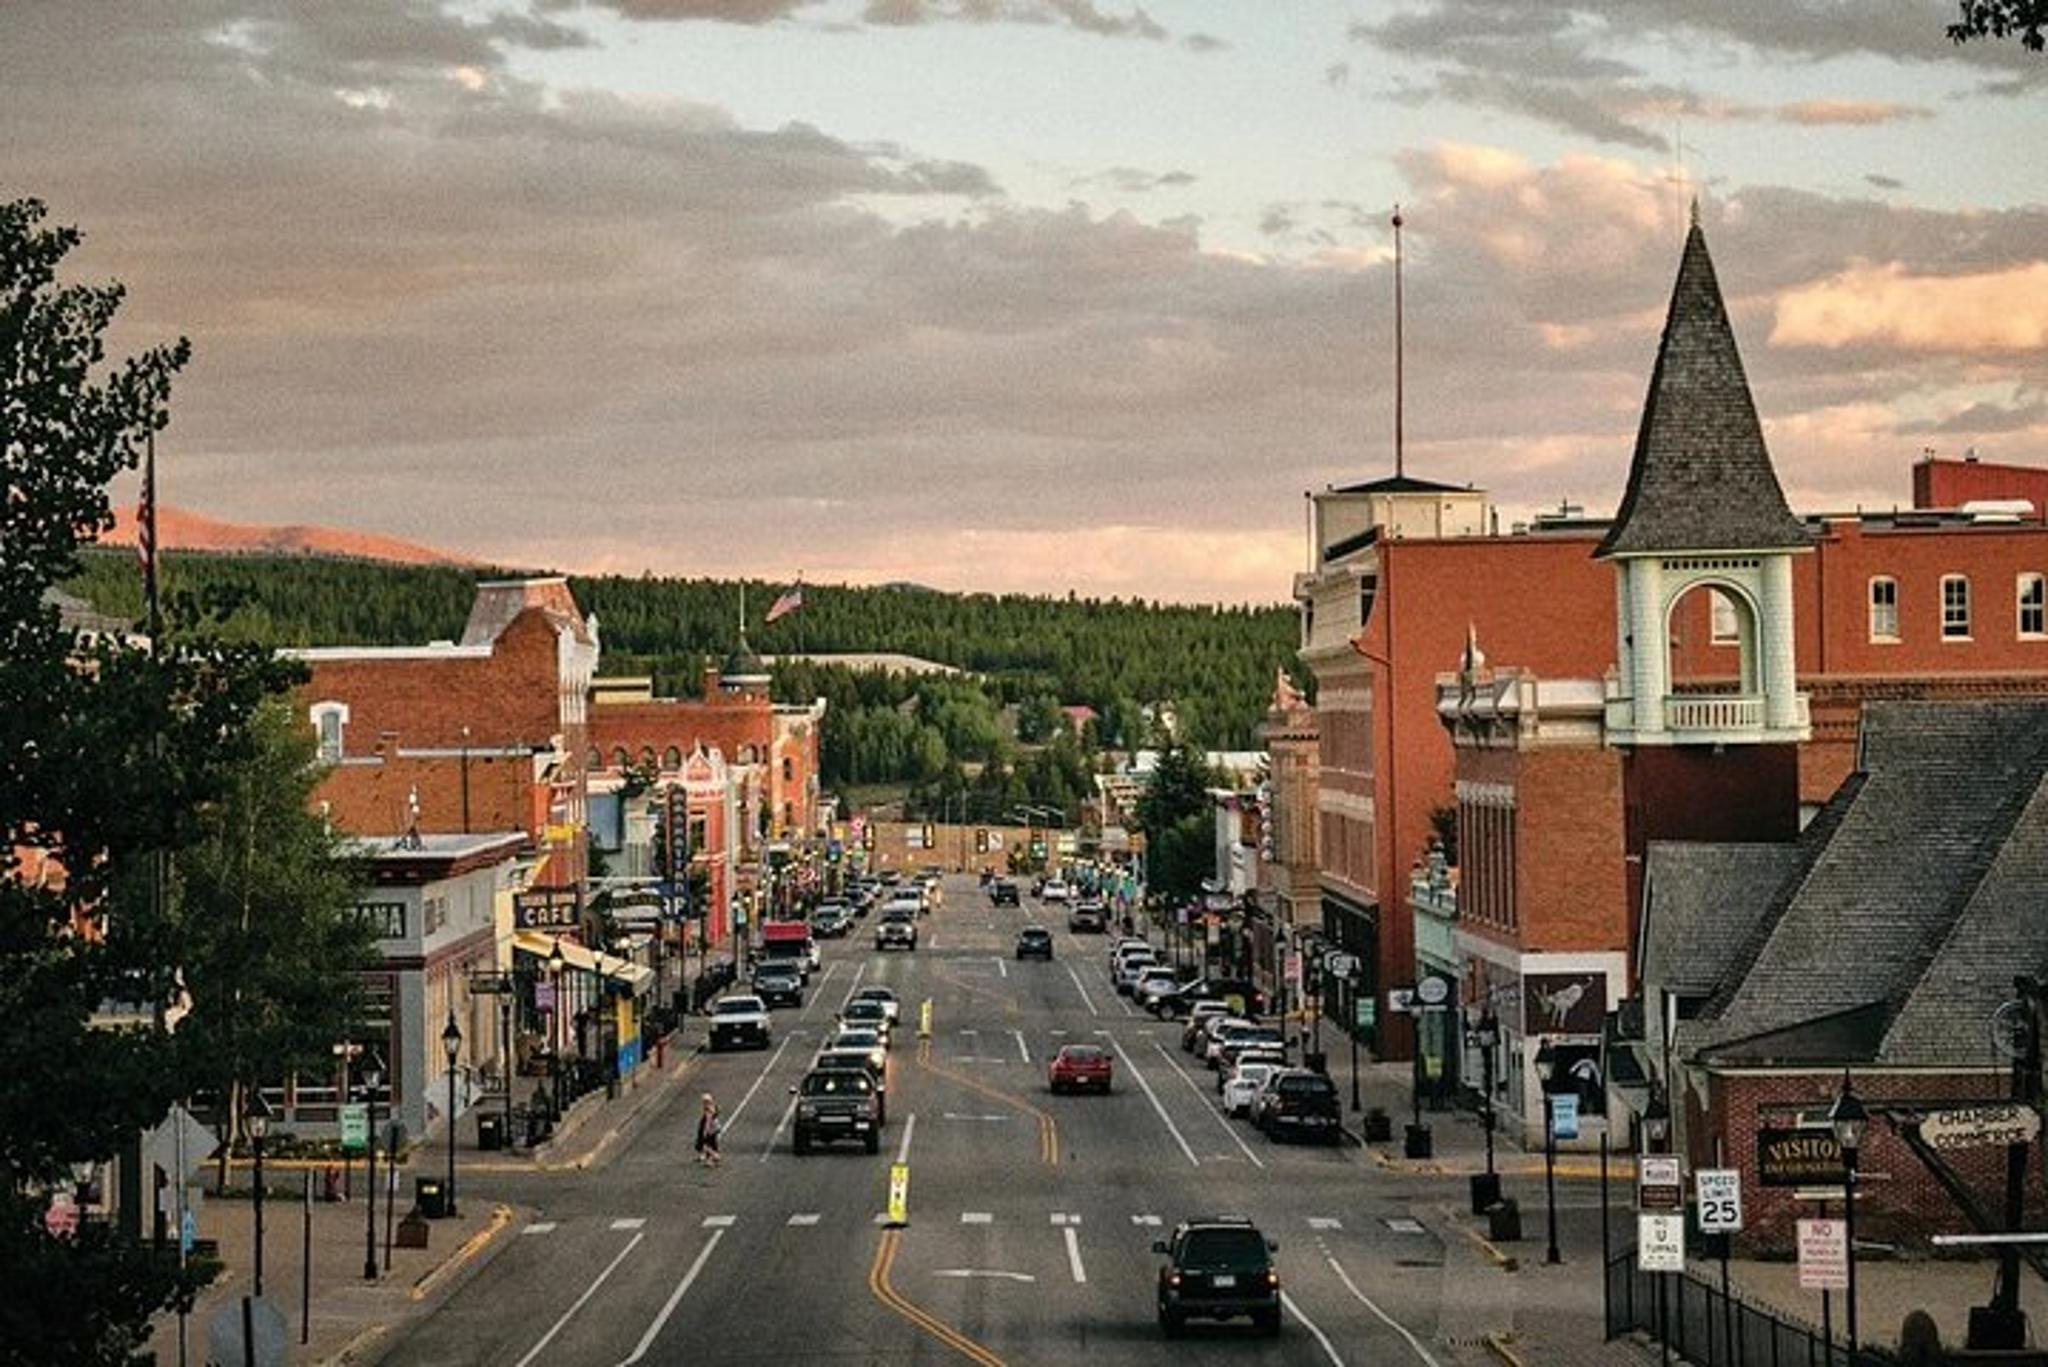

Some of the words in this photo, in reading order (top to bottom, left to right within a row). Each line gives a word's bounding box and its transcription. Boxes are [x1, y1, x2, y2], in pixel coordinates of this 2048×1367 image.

[523, 905, 574, 927] CAFE
[1939, 1105, 2019, 1125] CHAMBER
[1933, 1127, 2026, 1148] COMMERCE
[1700, 1175, 1736, 1186] SPEED
[1702, 1186, 1733, 1199] LIMIT
[1702, 1200, 1738, 1223] 25
[1655, 1229, 1668, 1242] U
[1811, 1222, 1833, 1237] NO
